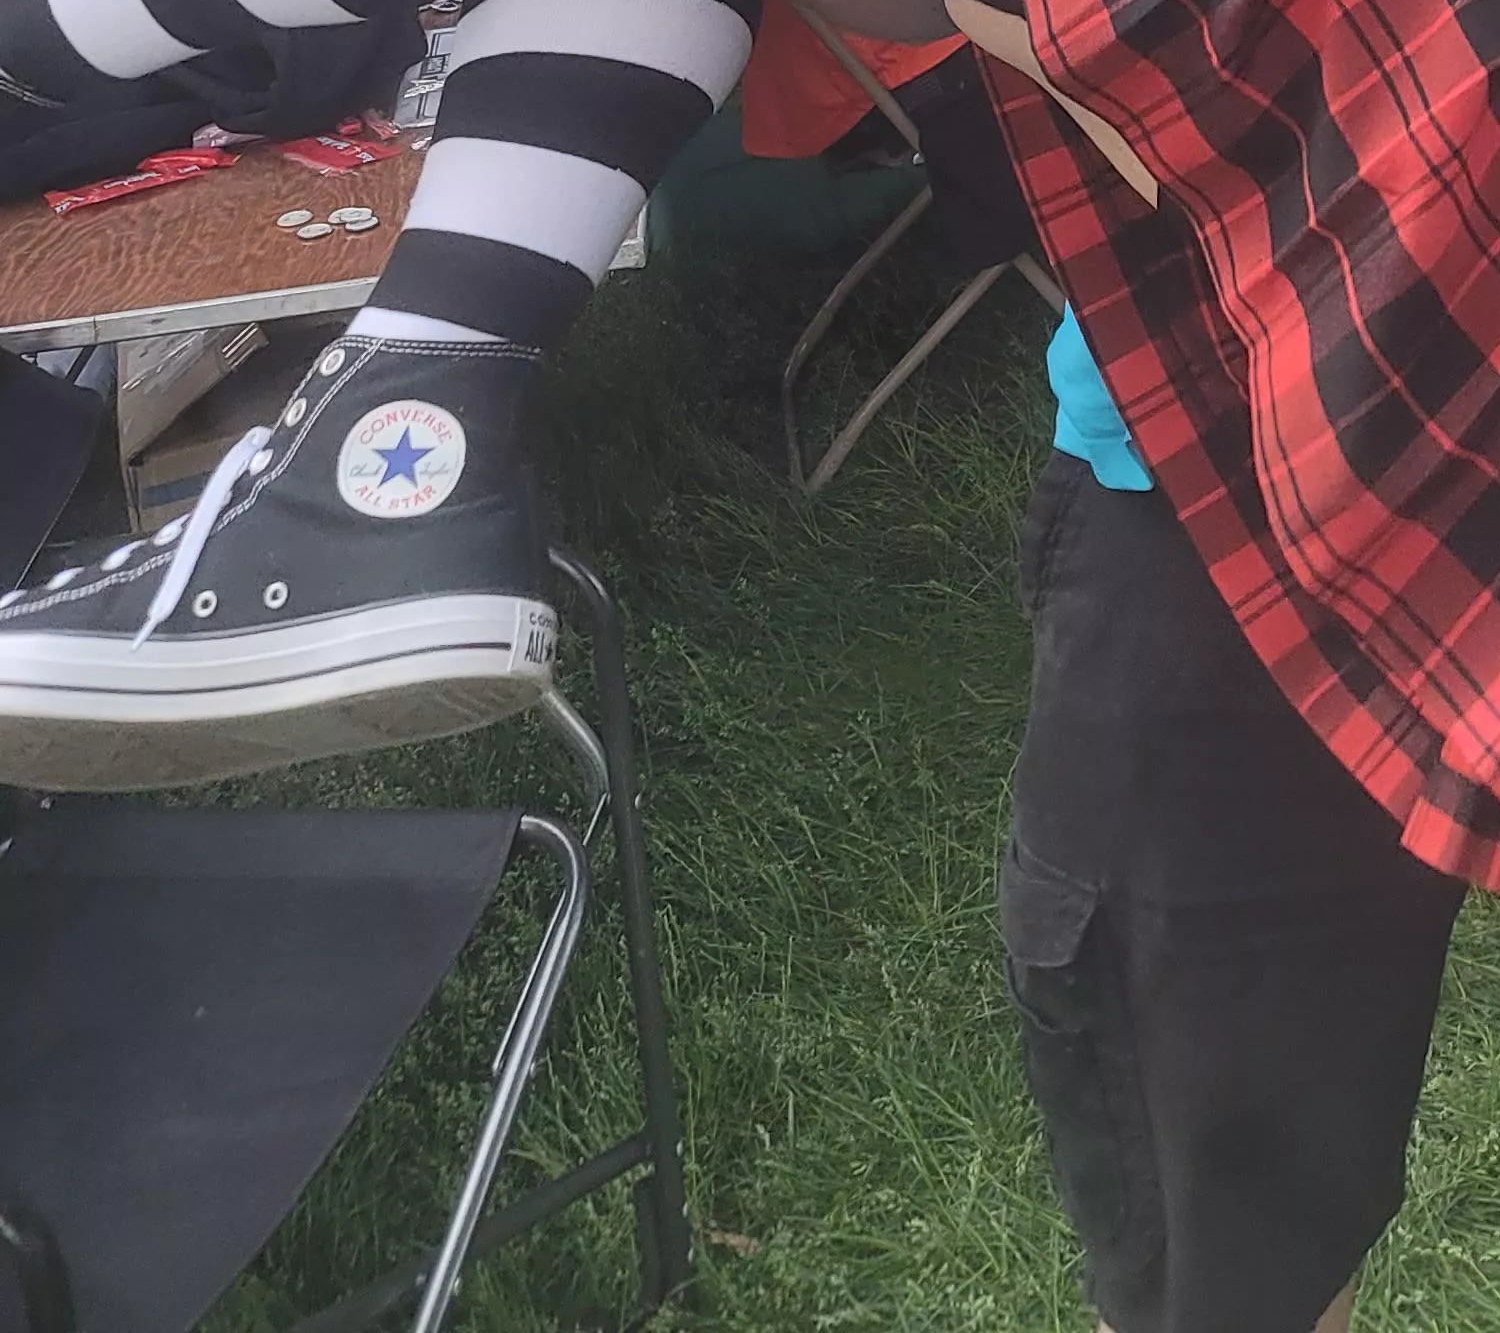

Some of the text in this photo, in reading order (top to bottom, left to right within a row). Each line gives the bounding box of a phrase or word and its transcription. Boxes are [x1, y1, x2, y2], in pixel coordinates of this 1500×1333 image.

[360, 408, 453, 445] CONVERSE
[355, 485, 437, 509] ALL STAR
